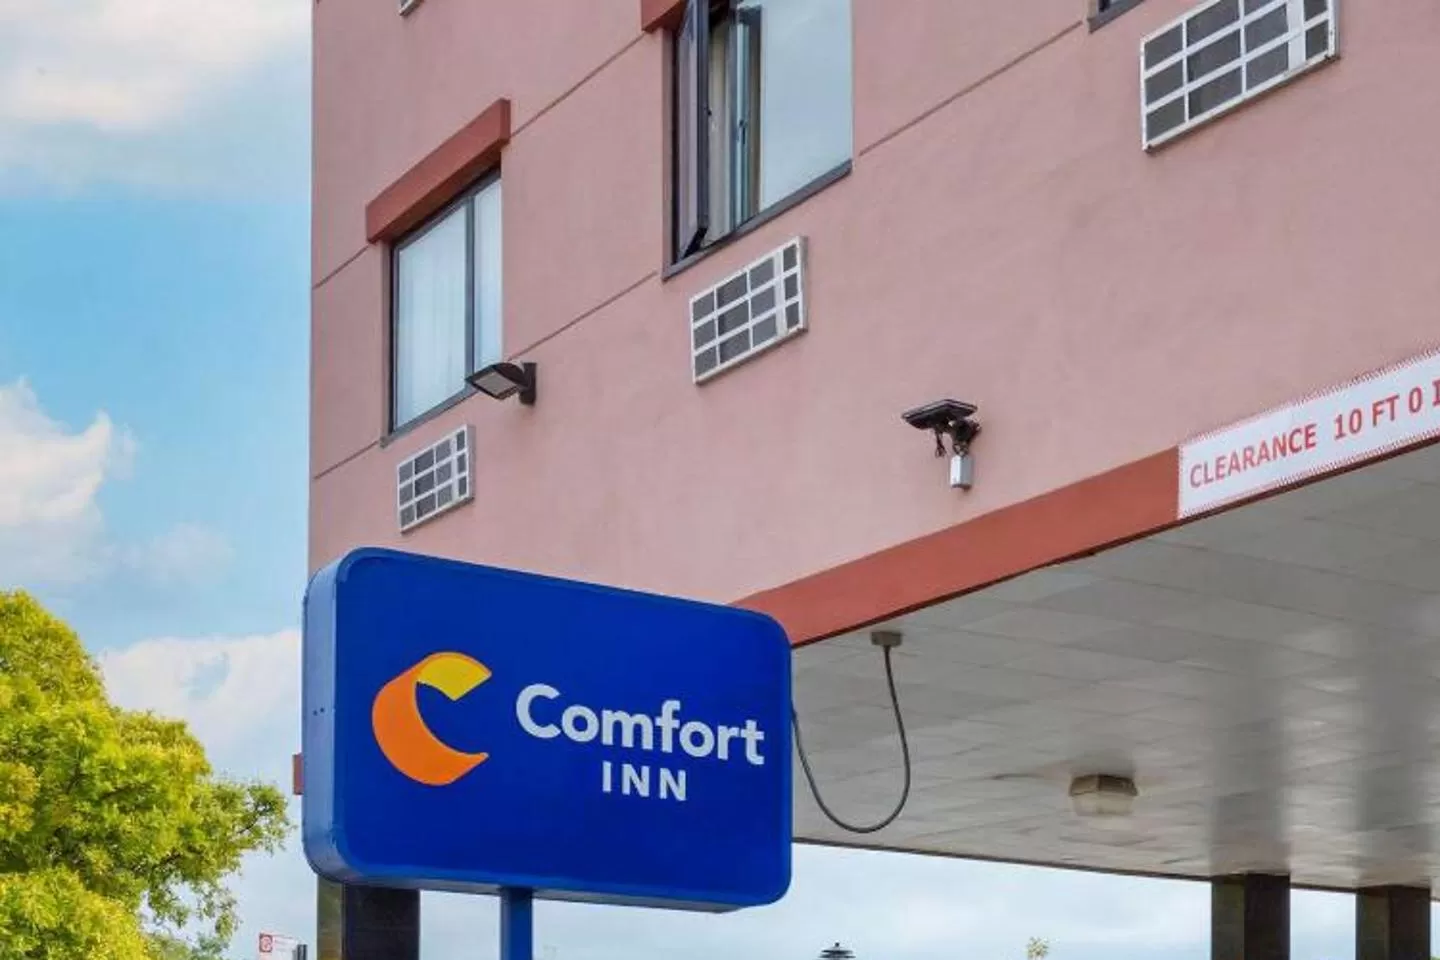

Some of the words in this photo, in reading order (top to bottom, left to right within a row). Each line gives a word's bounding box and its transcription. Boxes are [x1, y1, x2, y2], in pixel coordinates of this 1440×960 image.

[1189, 423, 1318, 488] CLEARANCE
[1333, 408, 1363, 441] 10
[1372, 395, 1400, 427] FT
[515, 682, 765, 765] Comfort
[602, 761, 687, 801] INN
